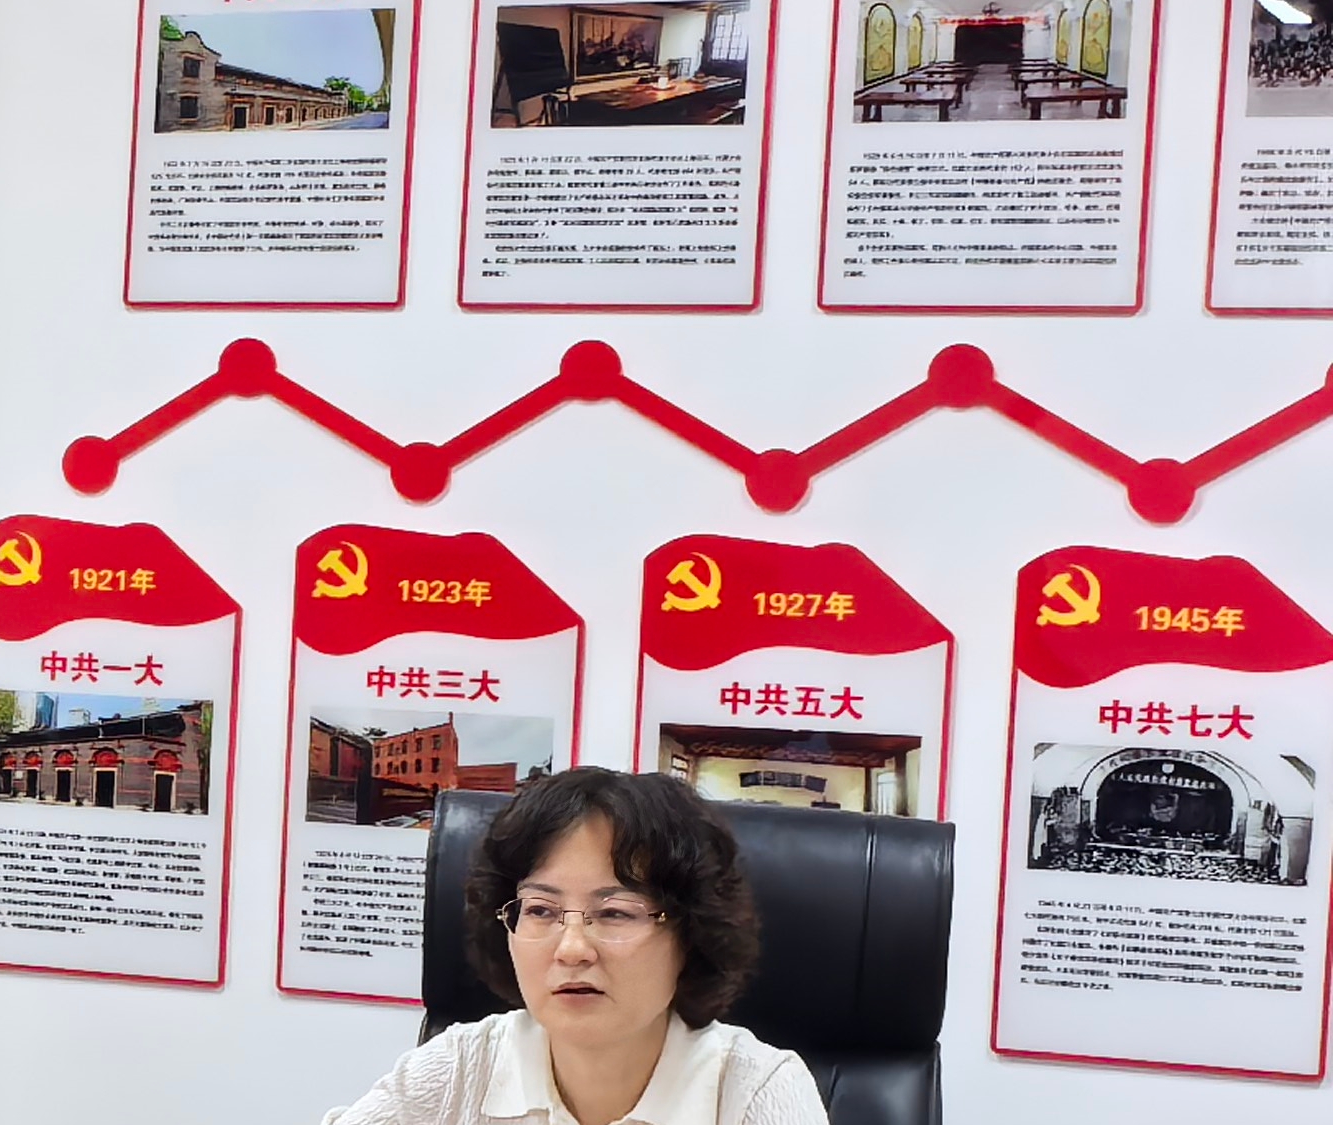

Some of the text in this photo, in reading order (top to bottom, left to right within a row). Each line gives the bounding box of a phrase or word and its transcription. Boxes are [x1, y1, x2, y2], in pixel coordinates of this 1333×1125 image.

[68, 567, 156, 596] 1921年
[396, 578, 492, 607] 1923年
[751, 590, 857, 621] 1927年
[1134, 604, 1245, 637] 1945年
[39, 650, 164, 687] 中共一大
[366, 665, 501, 702] 中共三大
[719, 682, 865, 720] 中共五大
[1097, 699, 1255, 740] 中共七大
